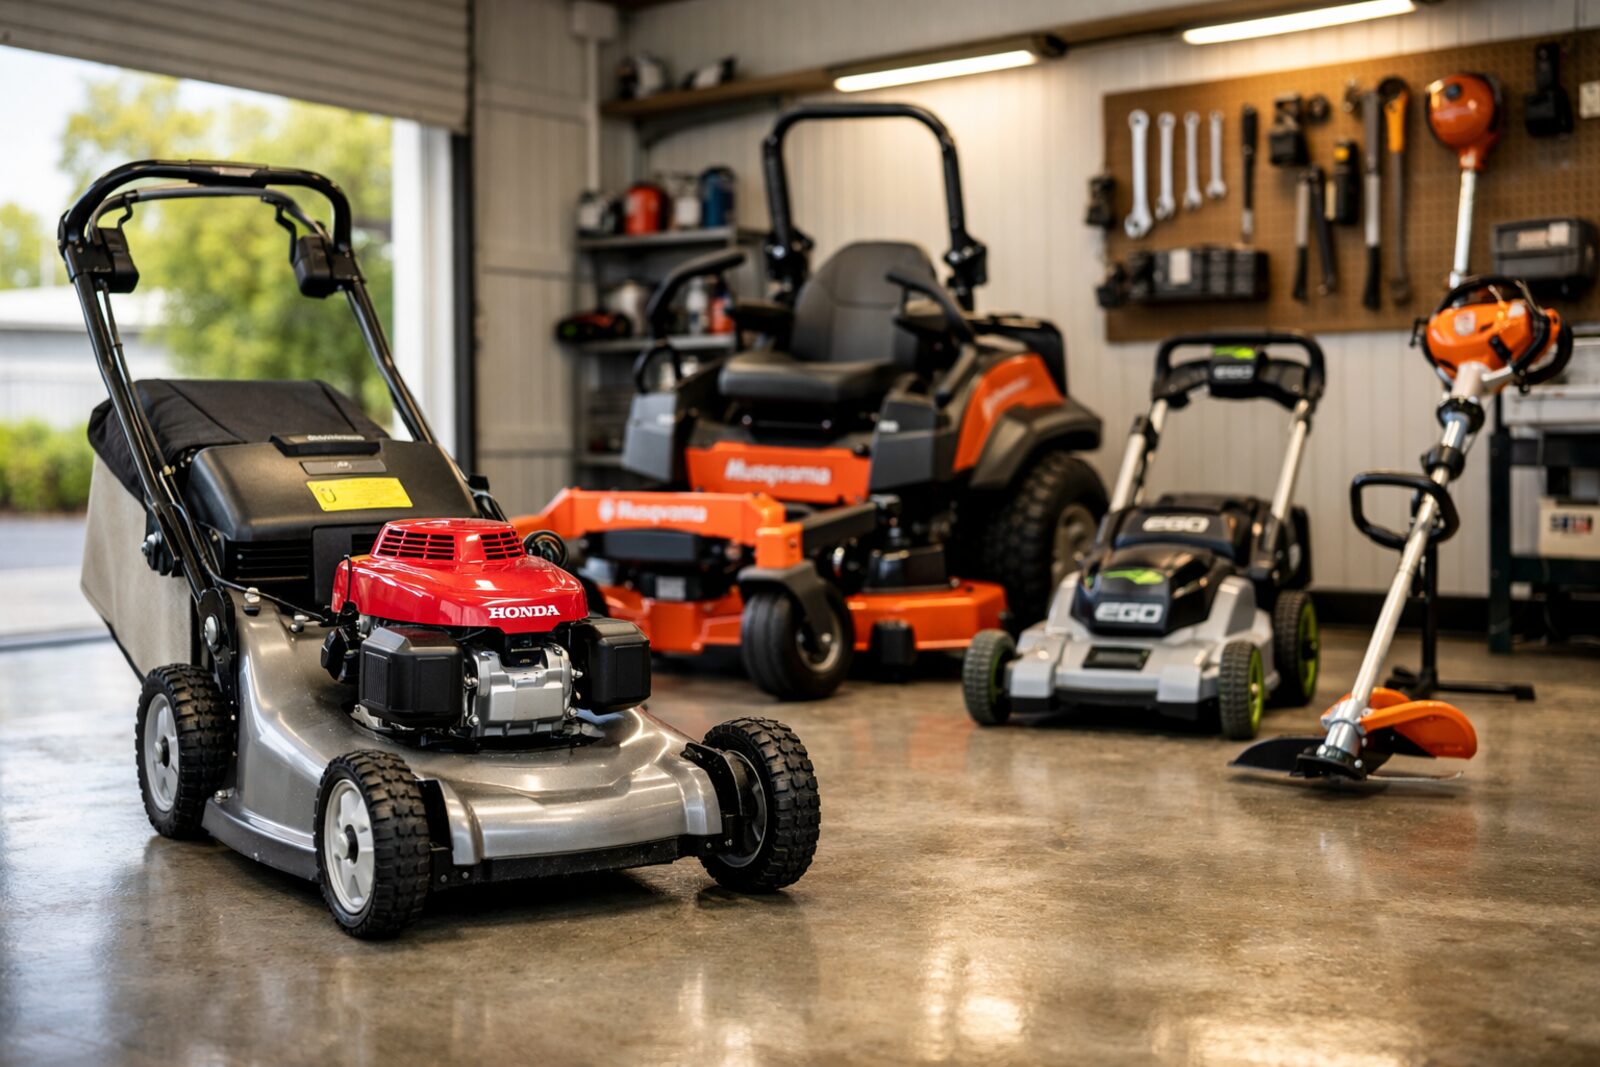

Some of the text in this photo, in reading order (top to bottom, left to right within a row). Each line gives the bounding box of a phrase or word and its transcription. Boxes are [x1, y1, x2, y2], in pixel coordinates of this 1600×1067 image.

[1143, 516, 1209, 533] EGO
[487, 604, 561, 620] HONDA
[1095, 602, 1163, 623] EGO
